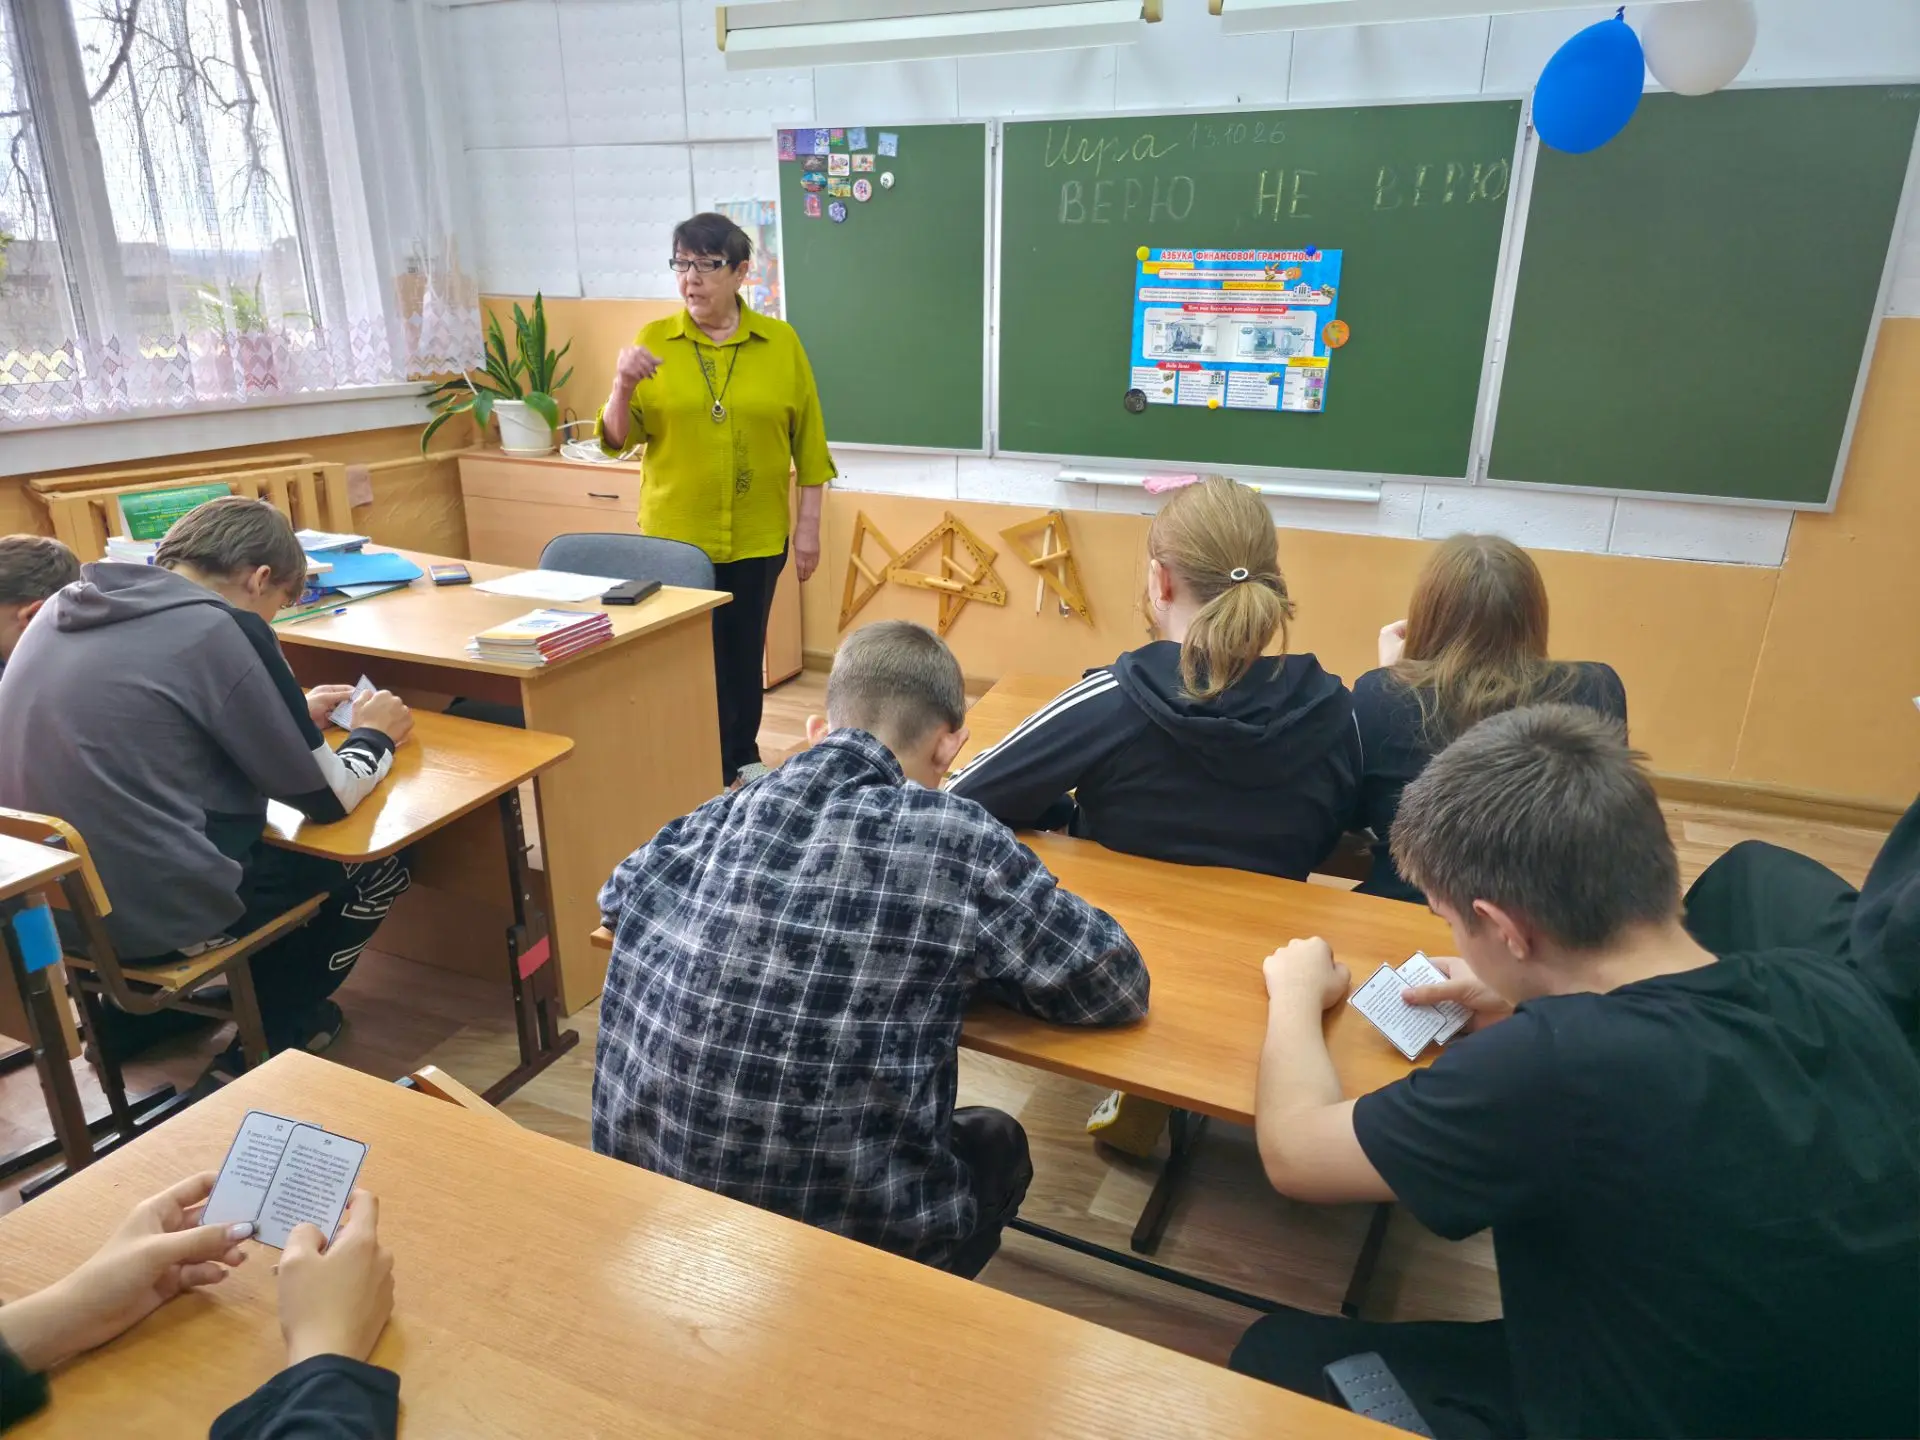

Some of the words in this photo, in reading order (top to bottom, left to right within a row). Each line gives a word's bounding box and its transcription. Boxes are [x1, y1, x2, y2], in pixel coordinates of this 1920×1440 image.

[1059, 175, 1195, 224] ВЕРЮ
[1252, 169, 1318, 222] НЕ
[1161, 250, 1193, 261] АЗБУКА
[1196, 250, 1254, 261] ФИНАНСОВОЙ
